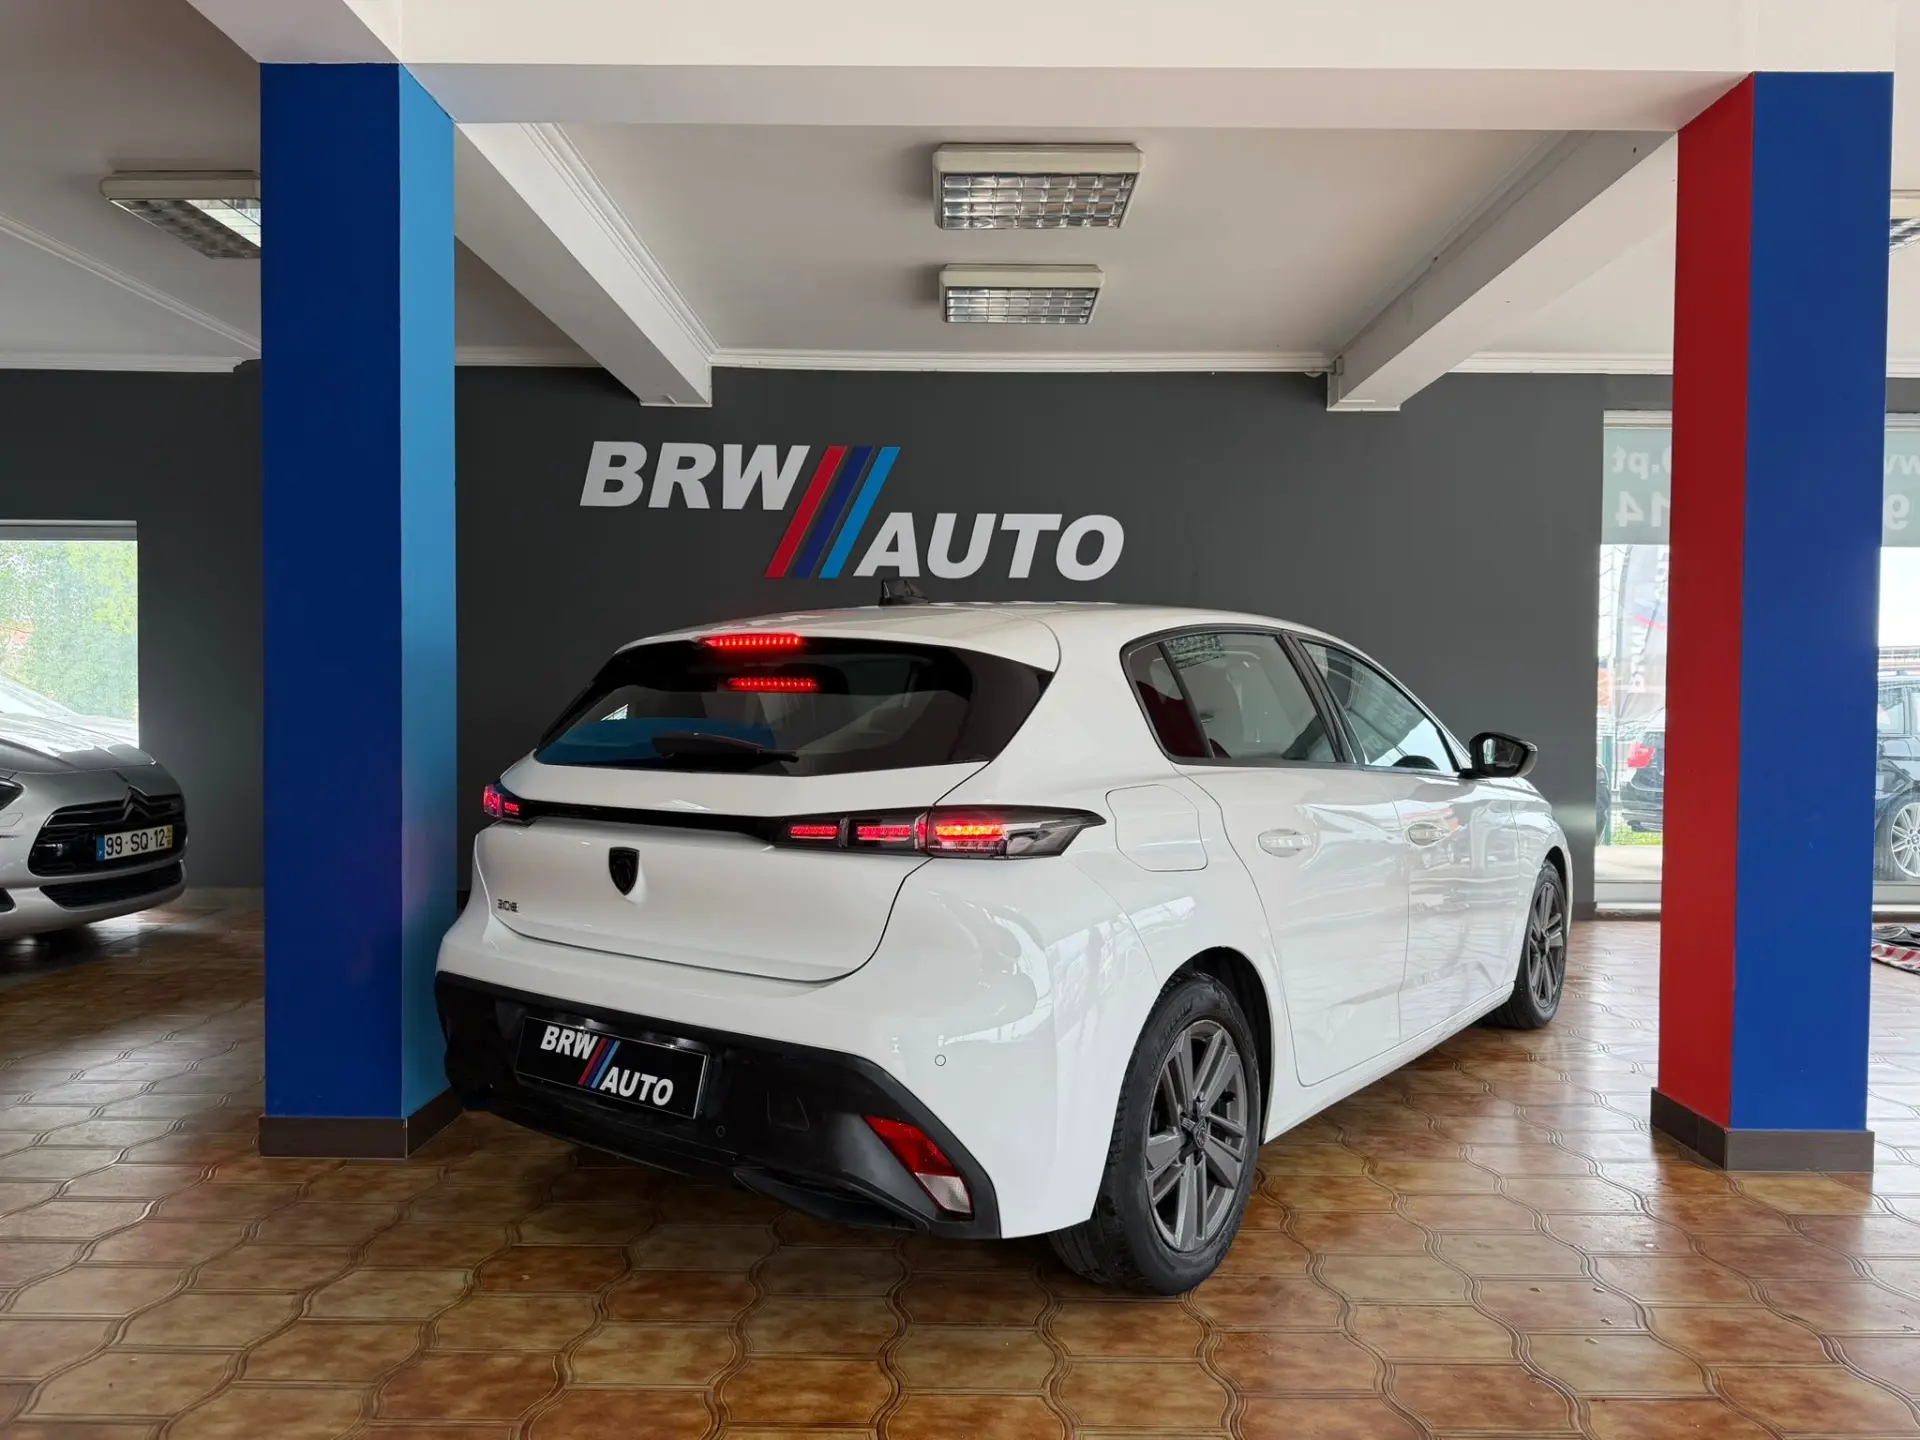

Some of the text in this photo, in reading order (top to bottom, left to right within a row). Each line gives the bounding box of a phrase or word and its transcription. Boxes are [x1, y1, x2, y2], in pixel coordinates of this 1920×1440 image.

[579, 440, 810, 511] BRW
[852, 511, 1125, 581] AUTO
[540, 1025, 599, 1060] BRW
[600, 1066, 674, 1106] AUTO
